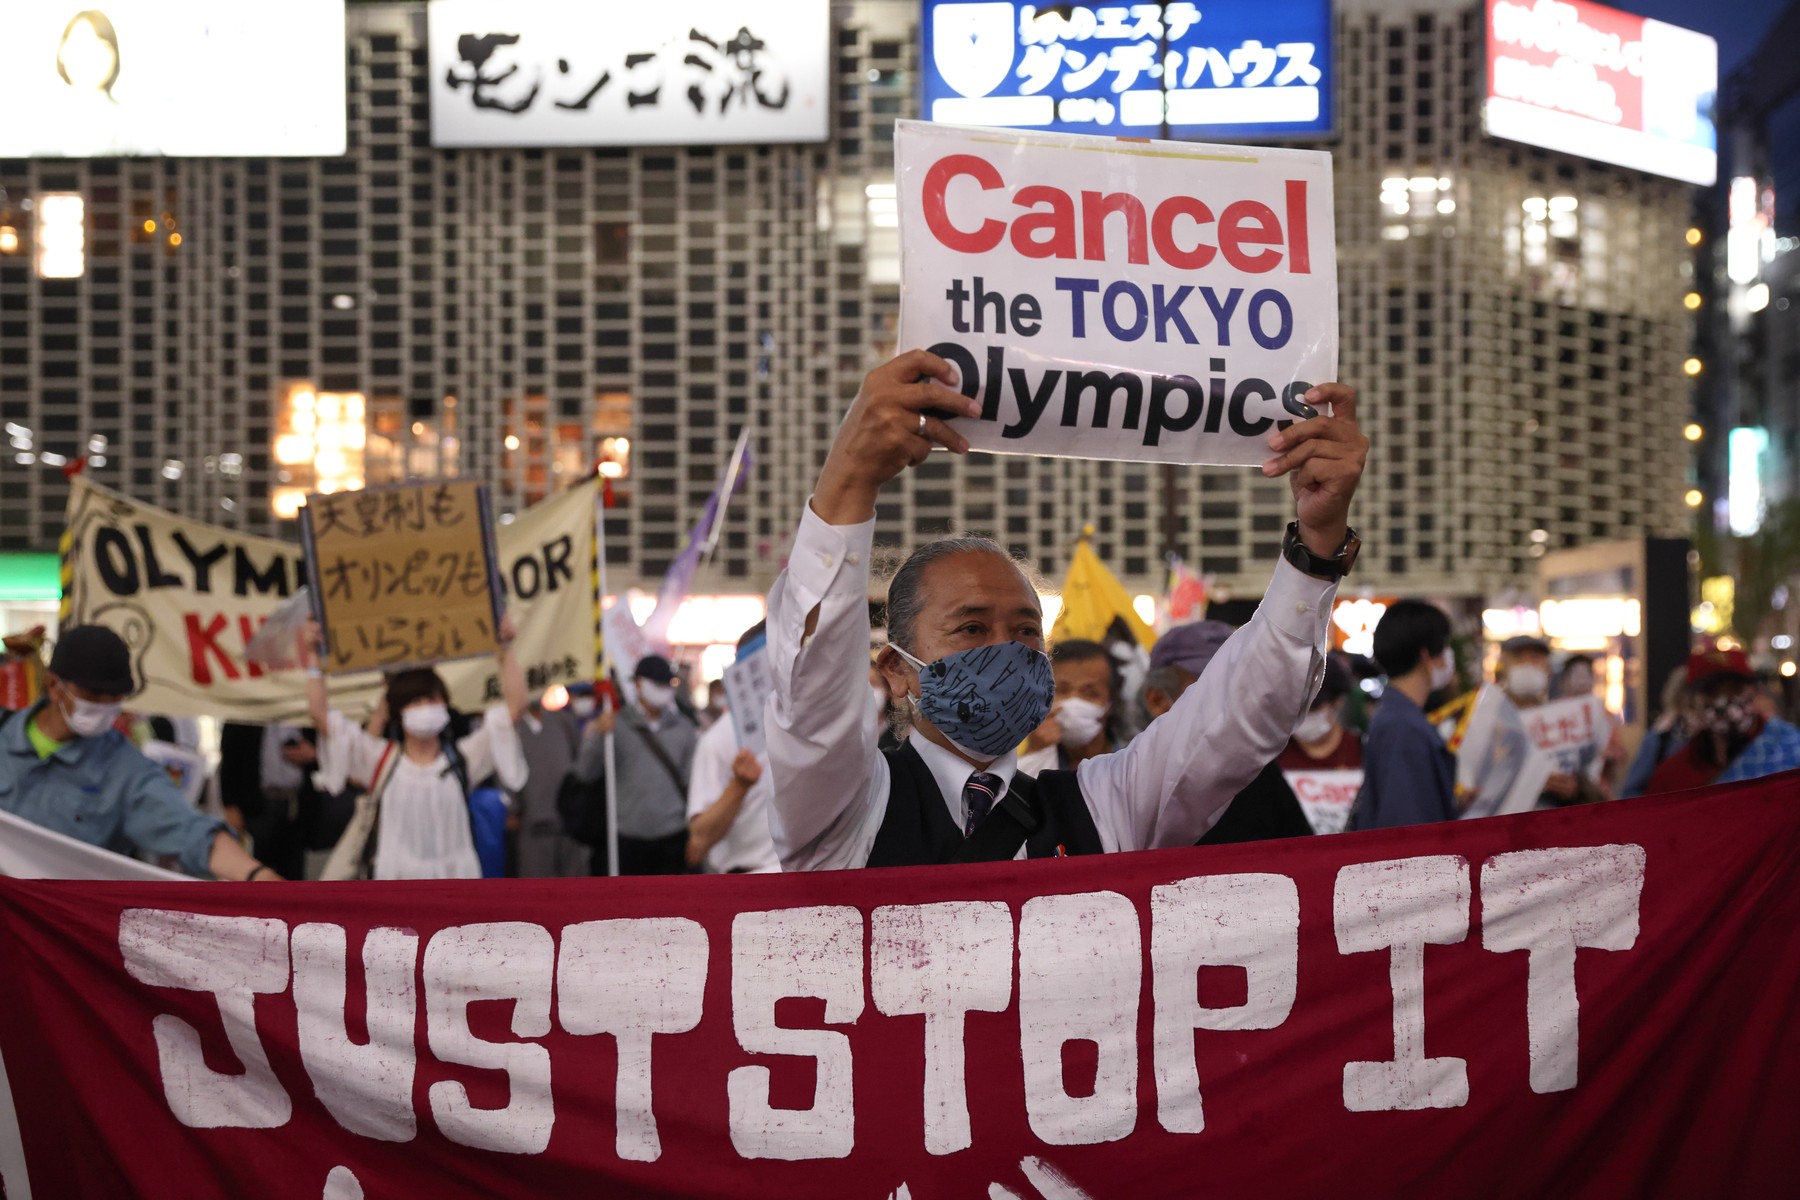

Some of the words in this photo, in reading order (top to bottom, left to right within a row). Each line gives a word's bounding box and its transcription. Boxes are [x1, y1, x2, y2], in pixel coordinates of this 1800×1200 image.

[1015, 40, 1321, 96] ダンディハウス
[921, 153, 1312, 275] Cancel
[946, 276, 1043, 338] the
[1055, 276, 1294, 351] TOKYO
[917, 342, 1321, 447] Olympics
[313, 484, 466, 540] 天皇制も
[95, 524, 307, 598] OLYM
[324, 549, 489, 600] オリンピックも
[330, 615, 490, 666] いらない
[118, 907, 709, 1163] JUST
[727, 872, 1300, 1161] STOP
[1332, 843, 1647, 1113] IT
